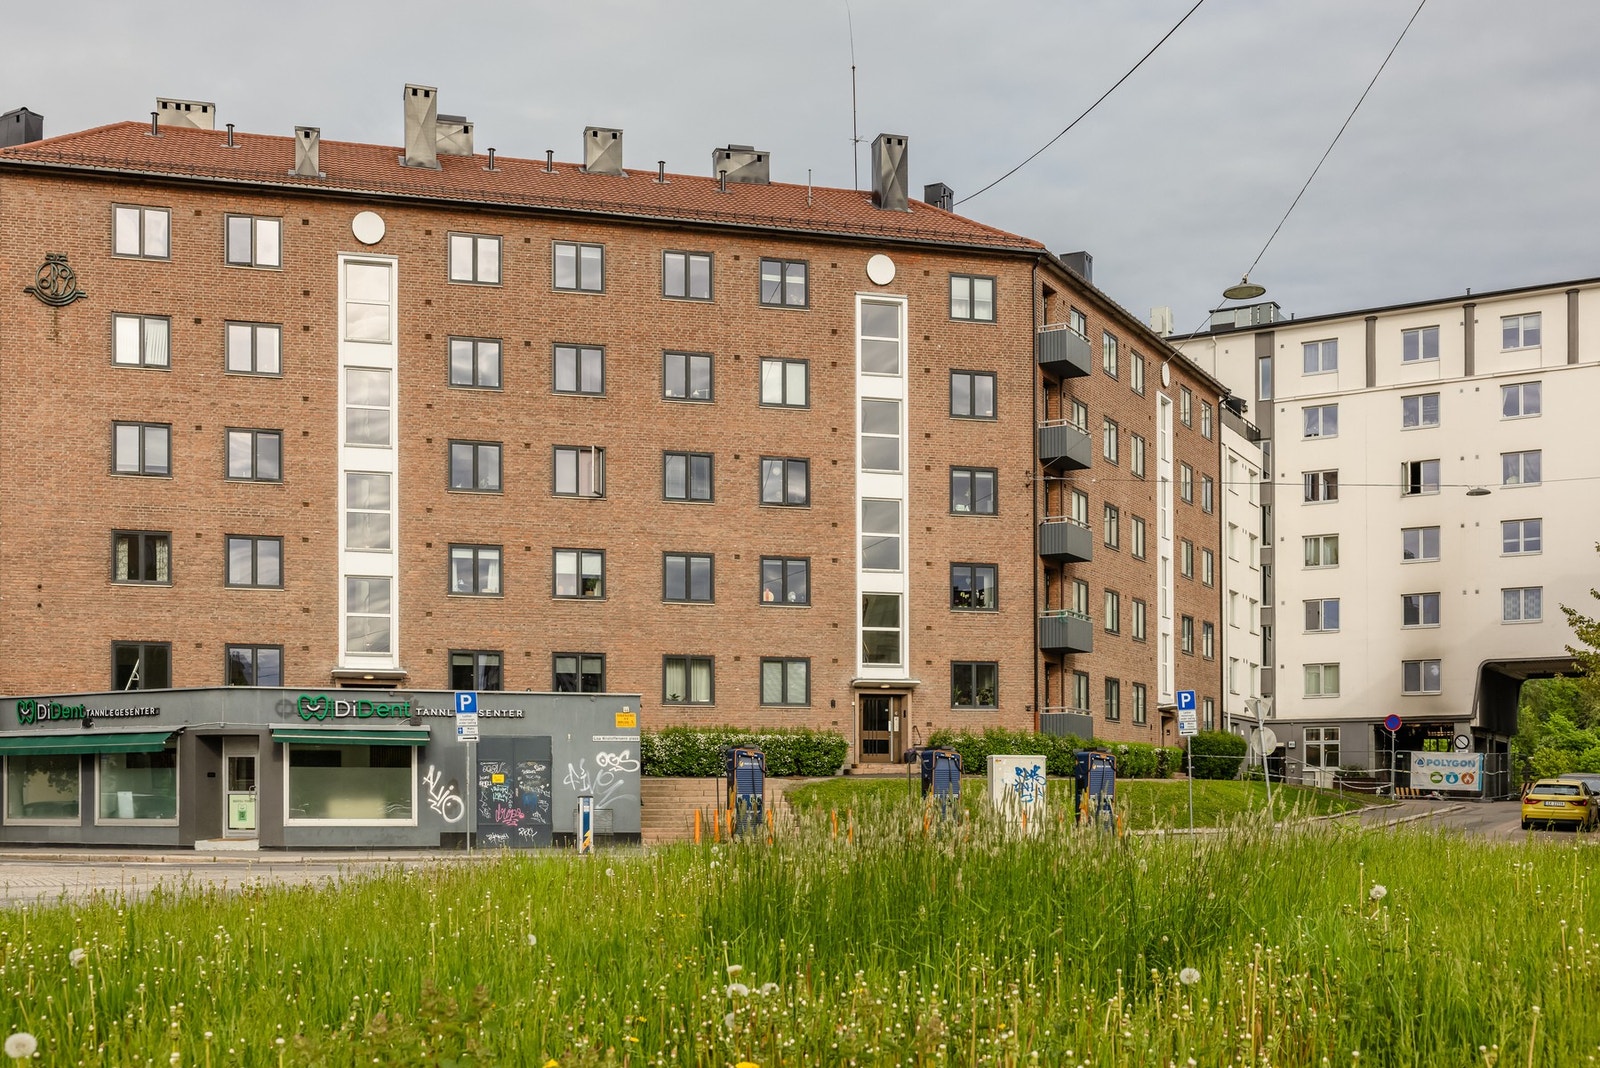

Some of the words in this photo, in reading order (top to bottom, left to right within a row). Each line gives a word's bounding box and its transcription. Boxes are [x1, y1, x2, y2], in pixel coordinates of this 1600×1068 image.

[335, 700, 412, 718] DiDent
[416, 707, 523, 717] TANNLSENTER
[460, 694, 472, 711] P
[1181, 693, 1191, 708] P
[37, 703, 86, 720] DiDent
[86, 707, 156, 717] TANNLEGESENTER
[1426, 758, 1476, 768] POLYGON
